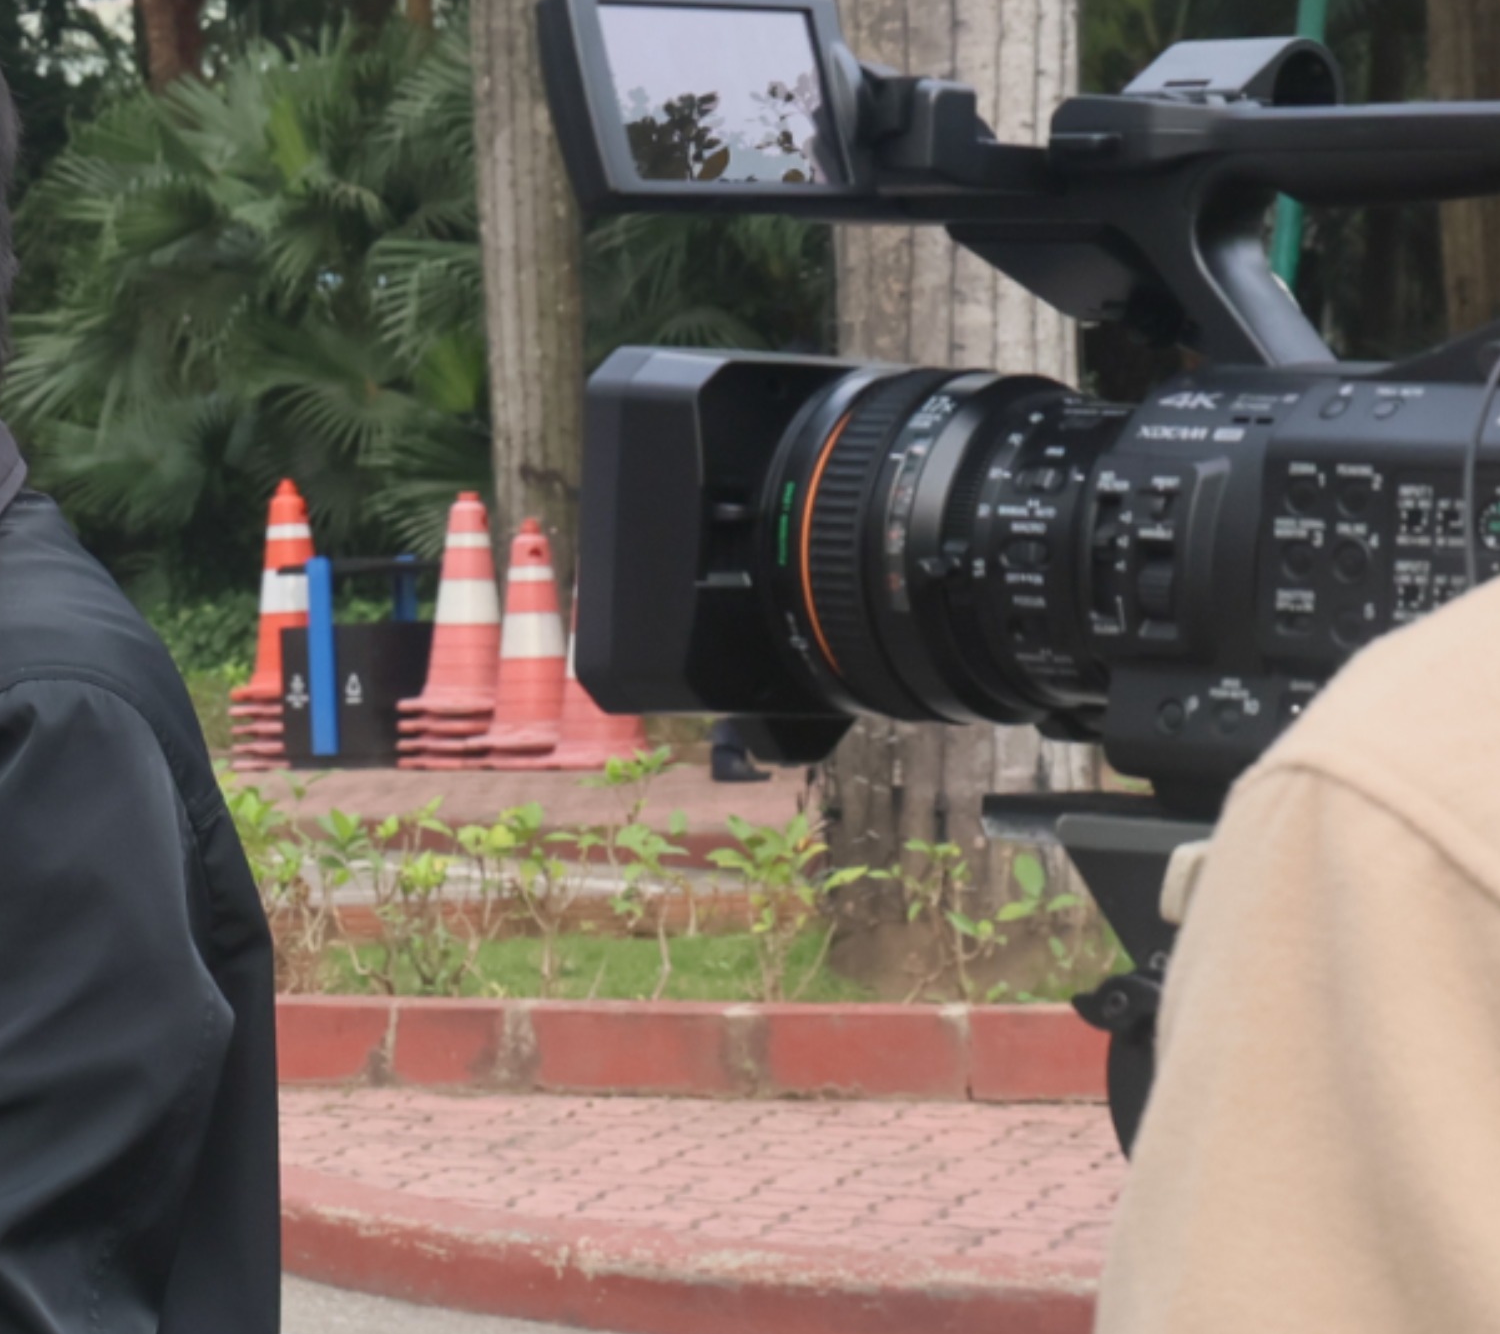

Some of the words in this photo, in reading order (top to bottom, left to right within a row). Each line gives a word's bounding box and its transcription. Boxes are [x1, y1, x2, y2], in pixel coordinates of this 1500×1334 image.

[1159, 391, 1224, 410] 4K
[1372, 473, 1383, 492] 2
[1312, 530, 1324, 548] 3
[1369, 533, 1379, 549] 4
[1243, 698, 1260, 716] 10
